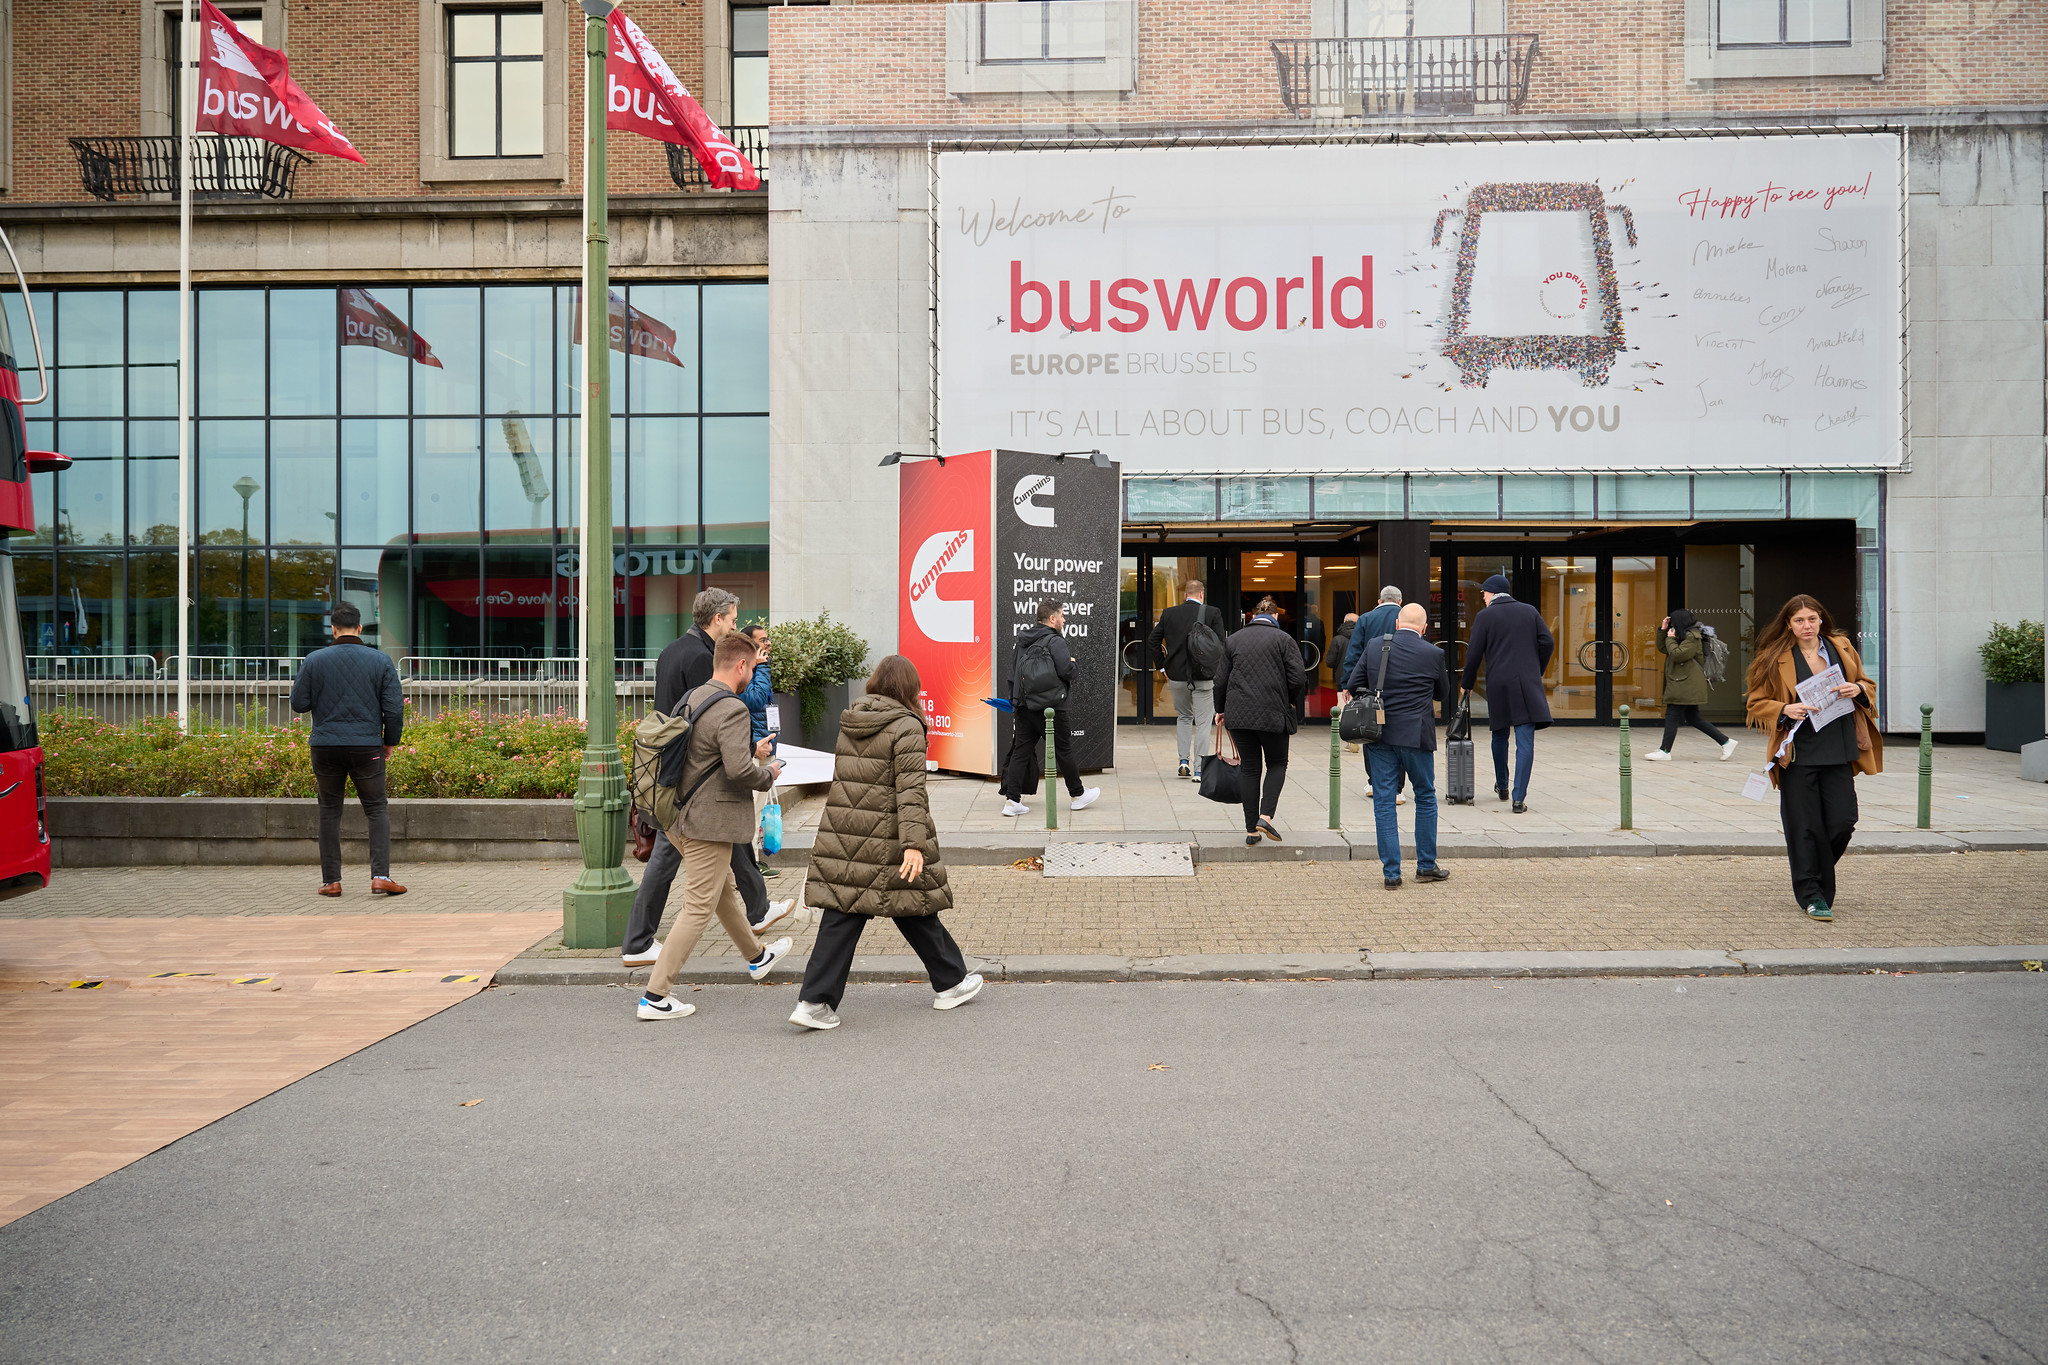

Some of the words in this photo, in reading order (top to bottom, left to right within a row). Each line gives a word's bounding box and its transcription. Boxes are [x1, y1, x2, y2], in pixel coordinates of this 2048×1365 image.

[1678, 187, 1758, 221] Happy
[1757, 181, 1787, 212] to
[1788, 188, 1820, 202] see
[1823, 171, 1872, 211] you!
[958, 196, 1095, 247] Welcome
[1092, 185, 1137, 234] to
[1692, 237, 1765, 266] Mieke
[1814, 227, 1868, 258] Sharon
[1766, 257, 1809, 280] Morena
[1010, 255, 1374, 333] busworld
[1542, 271, 1563, 285] YOU
[1565, 271, 1589, 296] DRIVE
[1578, 297, 1589, 311] US
[1010, 353, 1120, 376] EUROPE
[1127, 351, 1257, 375] BRUSSELS
[1695, 377, 1724, 419] Jan
[1010, 409, 1064, 437] IT'S
[1073, 409, 1131, 437] ALL
[1140, 408, 1252, 436] ABOUT
[1263, 407, 1335, 440] BUS,
[1345, 406, 1457, 435] COACH
[1468, 405, 1538, 433] AND
[1547, 404, 1621, 433] YOU
[1013, 475, 1051, 506] Cummins
[910, 529, 968, 602] Cummins
[1013, 552, 1051, 571] Your
[1054, 558, 1103, 576] power
[1013, 577, 1076, 597] partner,
[1013, 597, 1094, 616] whever
[1061, 623, 1088, 639] you
[927, 699, 934, 712] 8
[935, 715, 951, 728] 810
